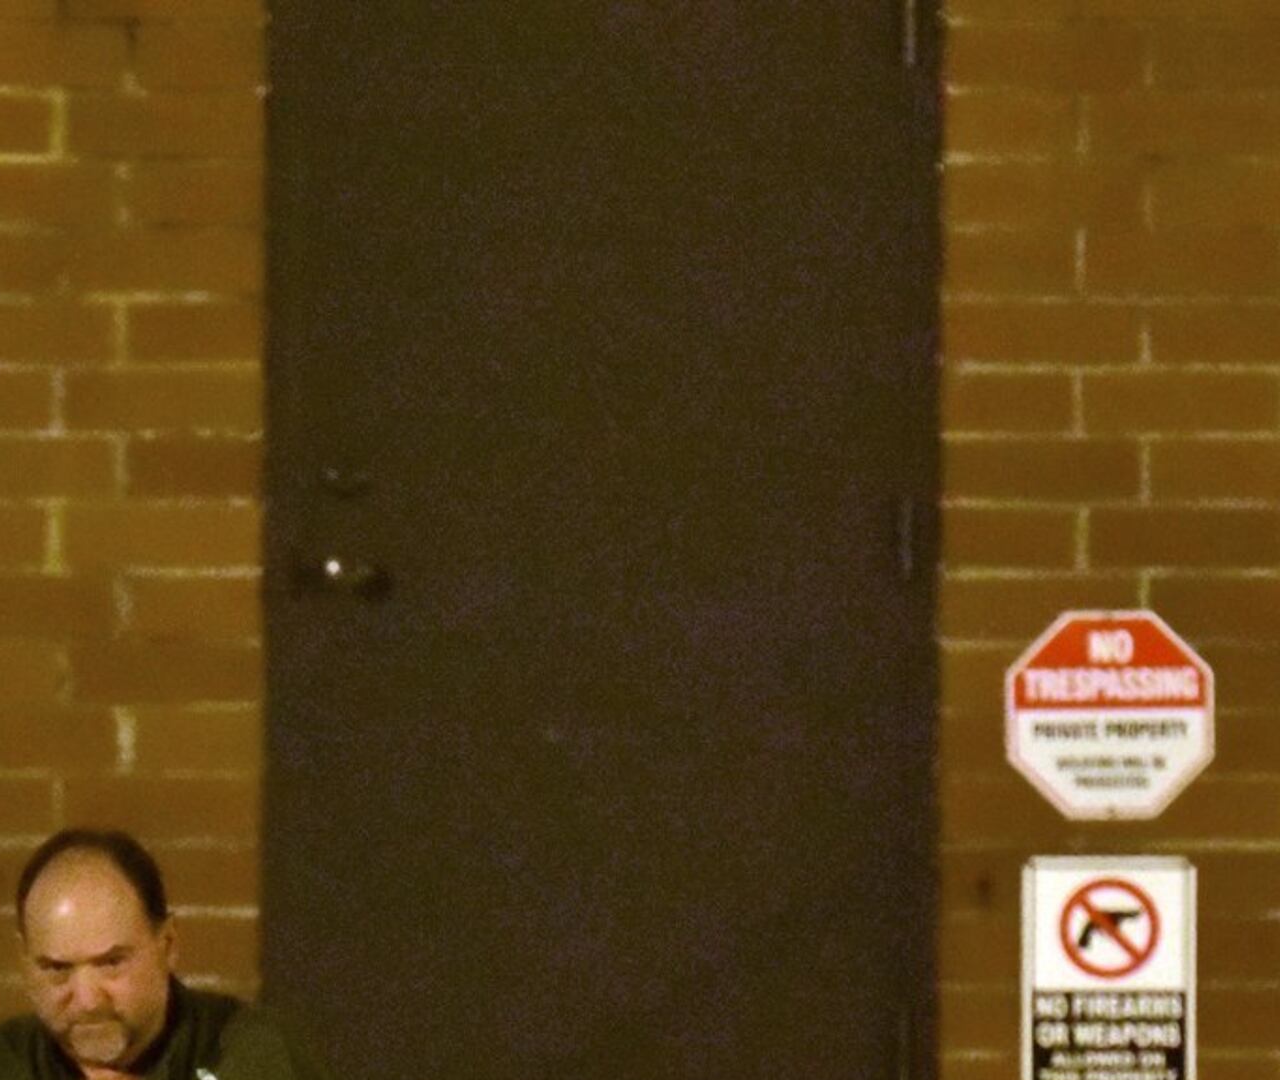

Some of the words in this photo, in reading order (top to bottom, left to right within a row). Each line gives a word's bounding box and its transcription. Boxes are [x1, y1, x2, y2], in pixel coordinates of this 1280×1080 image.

[1088, 630, 1134, 664] NO
[1024, 667, 1200, 701] TRESPASSING
[1033, 720, 1097, 739] PRIVATE
[1105, 719, 1187, 738] PROPERTY
[1034, 995, 1069, 1019] NO
[1071, 995, 1183, 1020] FIREARMS
[1035, 1022, 1069, 1047] OR
[1072, 1022, 1181, 1048] WEAPONS
